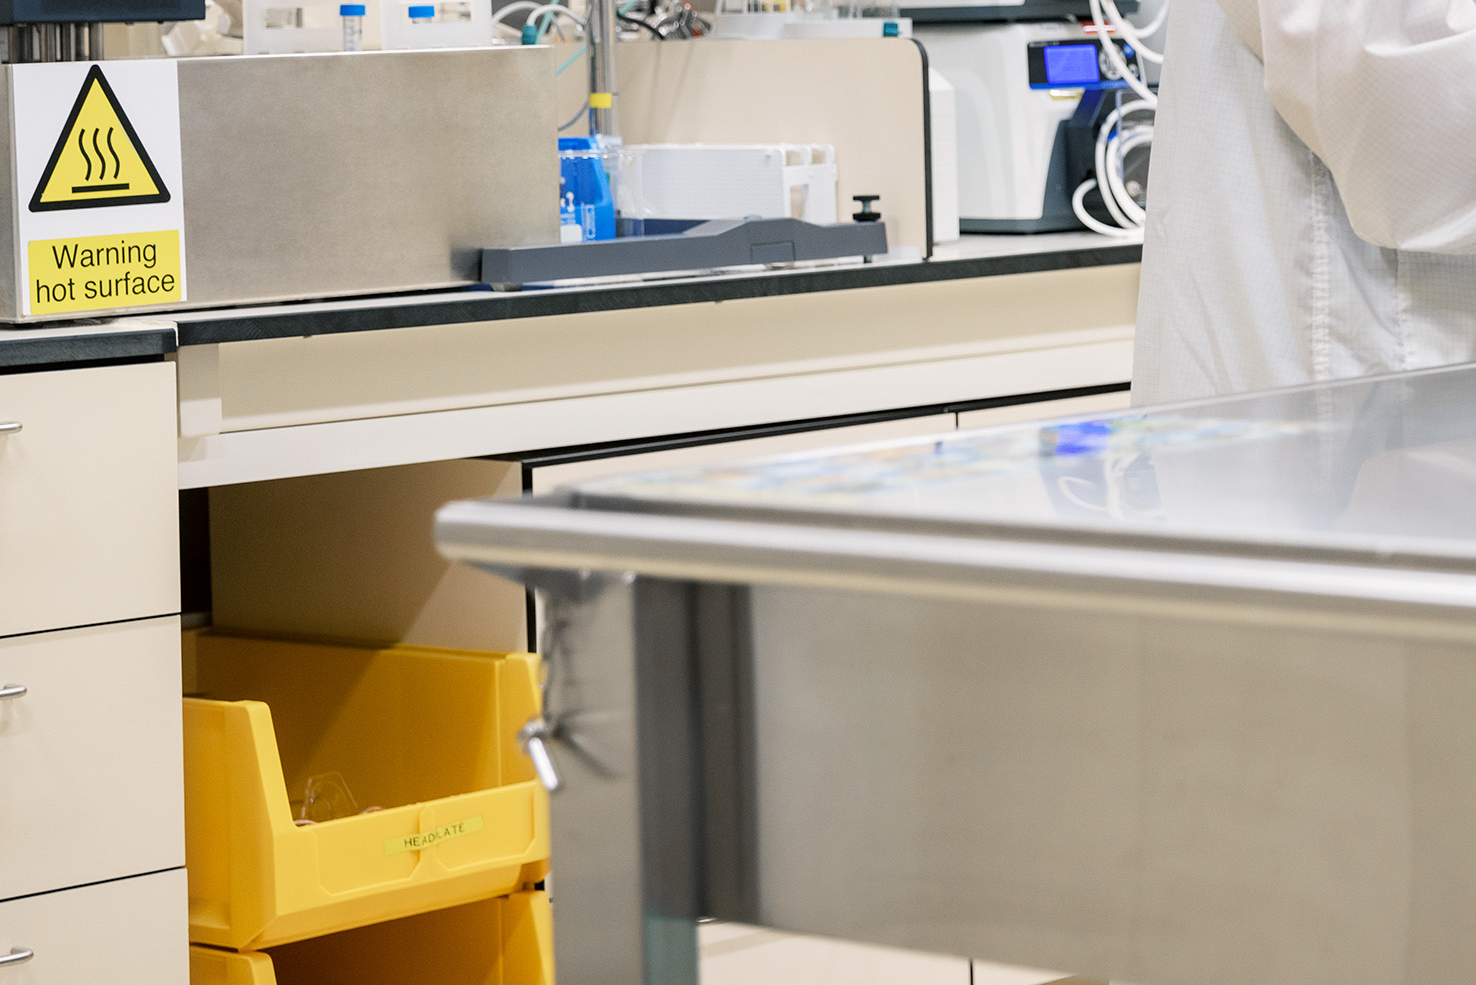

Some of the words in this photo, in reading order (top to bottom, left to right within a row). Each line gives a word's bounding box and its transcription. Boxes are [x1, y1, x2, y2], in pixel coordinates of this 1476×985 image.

[52, 240, 156, 269] Warning
[36, 278, 76, 303] hot
[84, 271, 175, 299] surface
